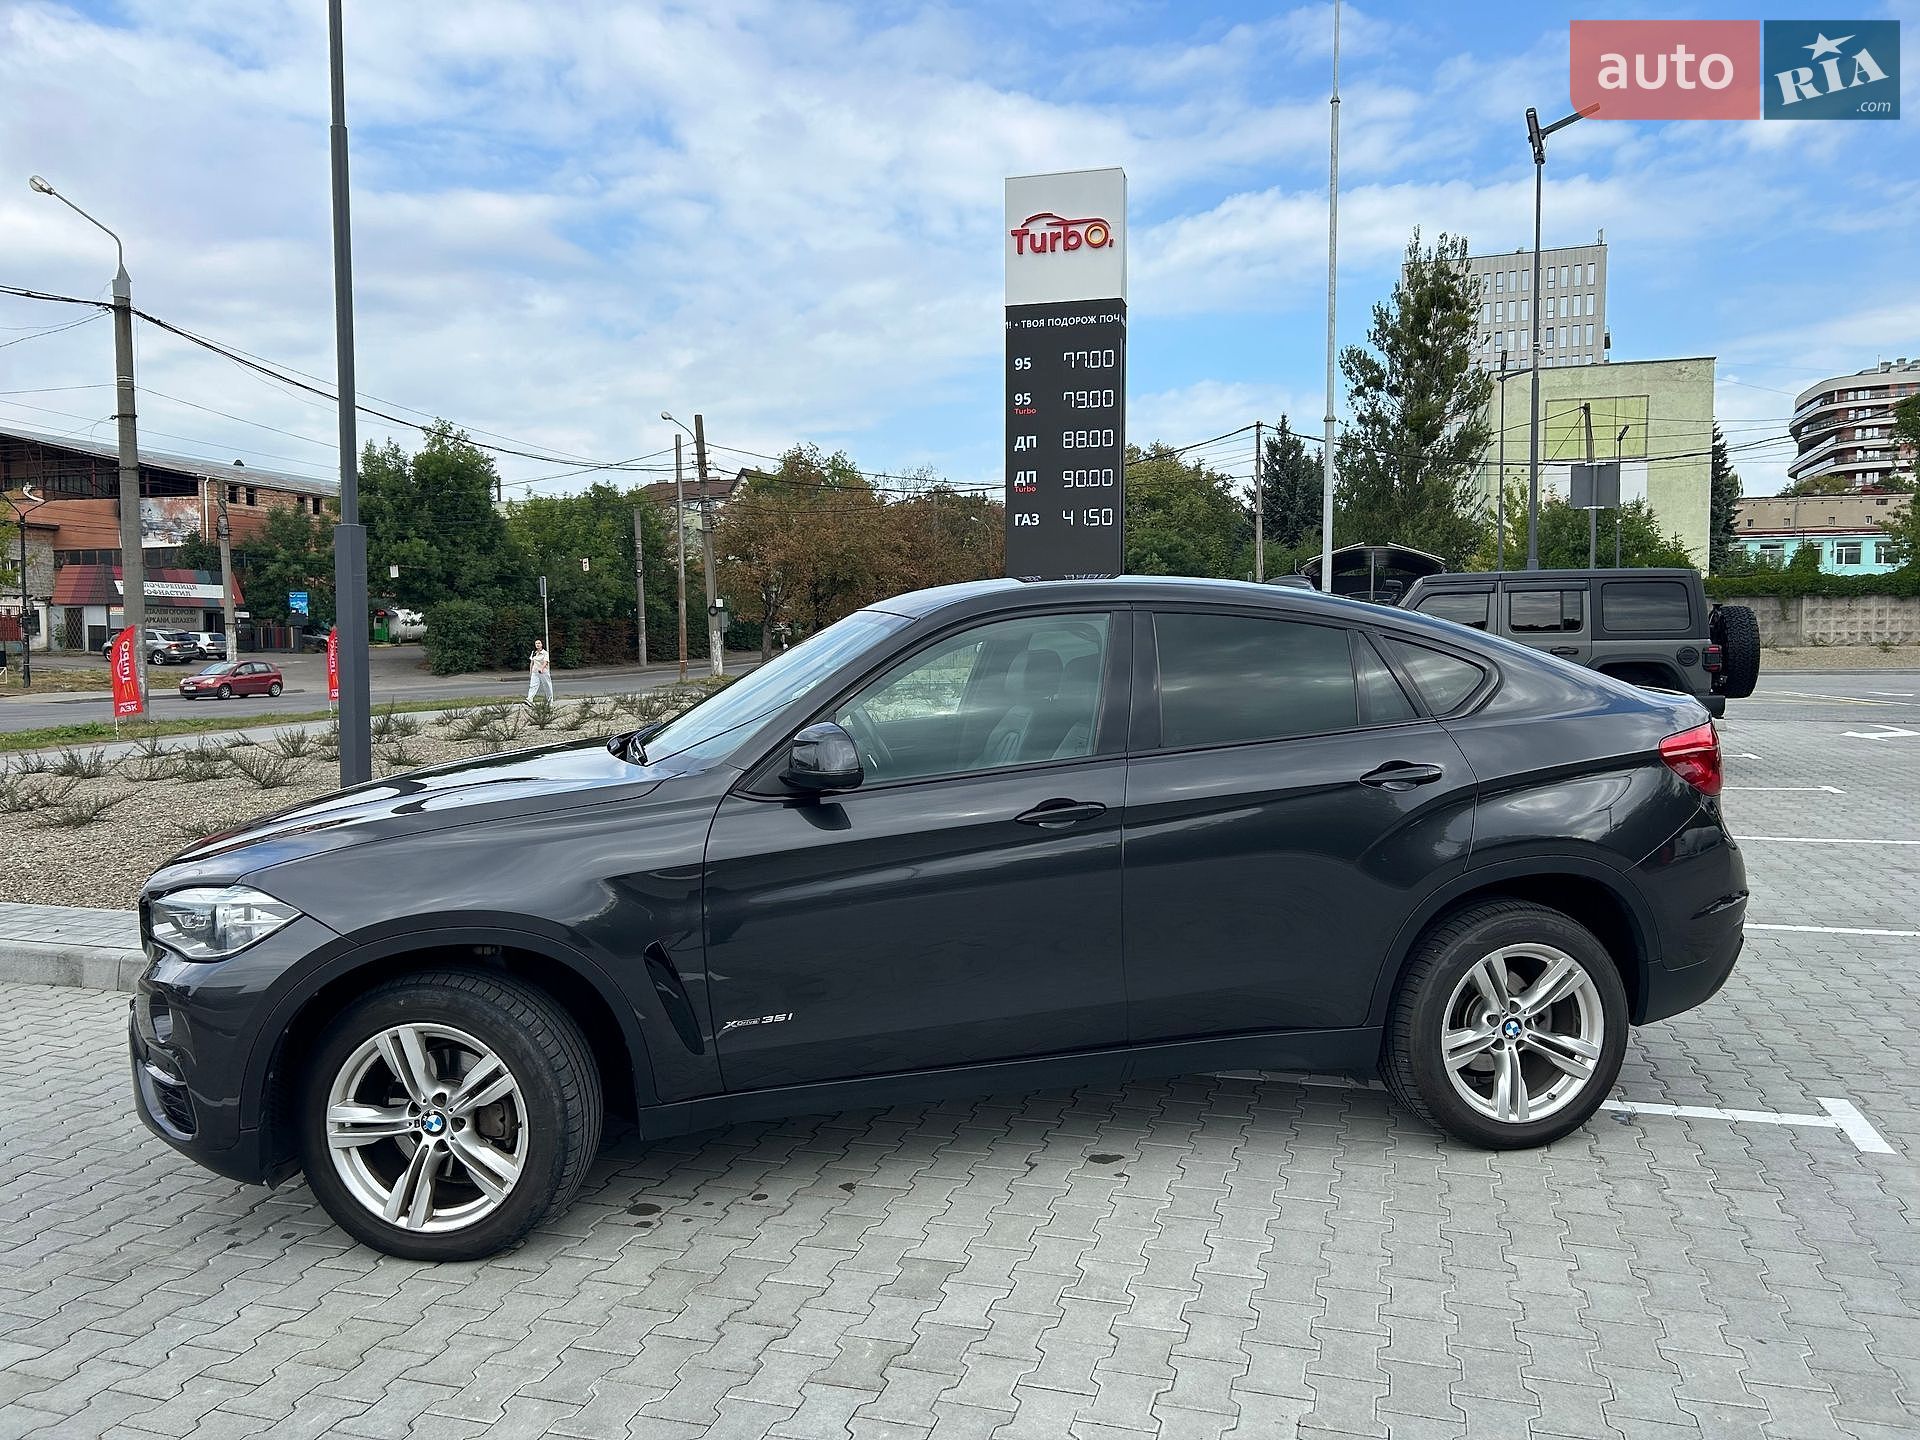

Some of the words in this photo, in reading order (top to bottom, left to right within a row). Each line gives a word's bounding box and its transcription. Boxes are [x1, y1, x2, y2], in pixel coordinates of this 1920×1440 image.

[1021, 318, 1045, 329] ТВОЯ
[1047, 315, 1097, 328] ПОДОРОЖ
[1014, 357, 1032, 371] 95
[1014, 392, 1032, 406] 95
[1014, 407, 1037, 415] Turbo
[1014, 435, 1037, 452] ДП
[1014, 470, 1037, 487] ДП
[1014, 513, 1040, 527] ГАЗ
[120, 704, 138, 713] АЗК
